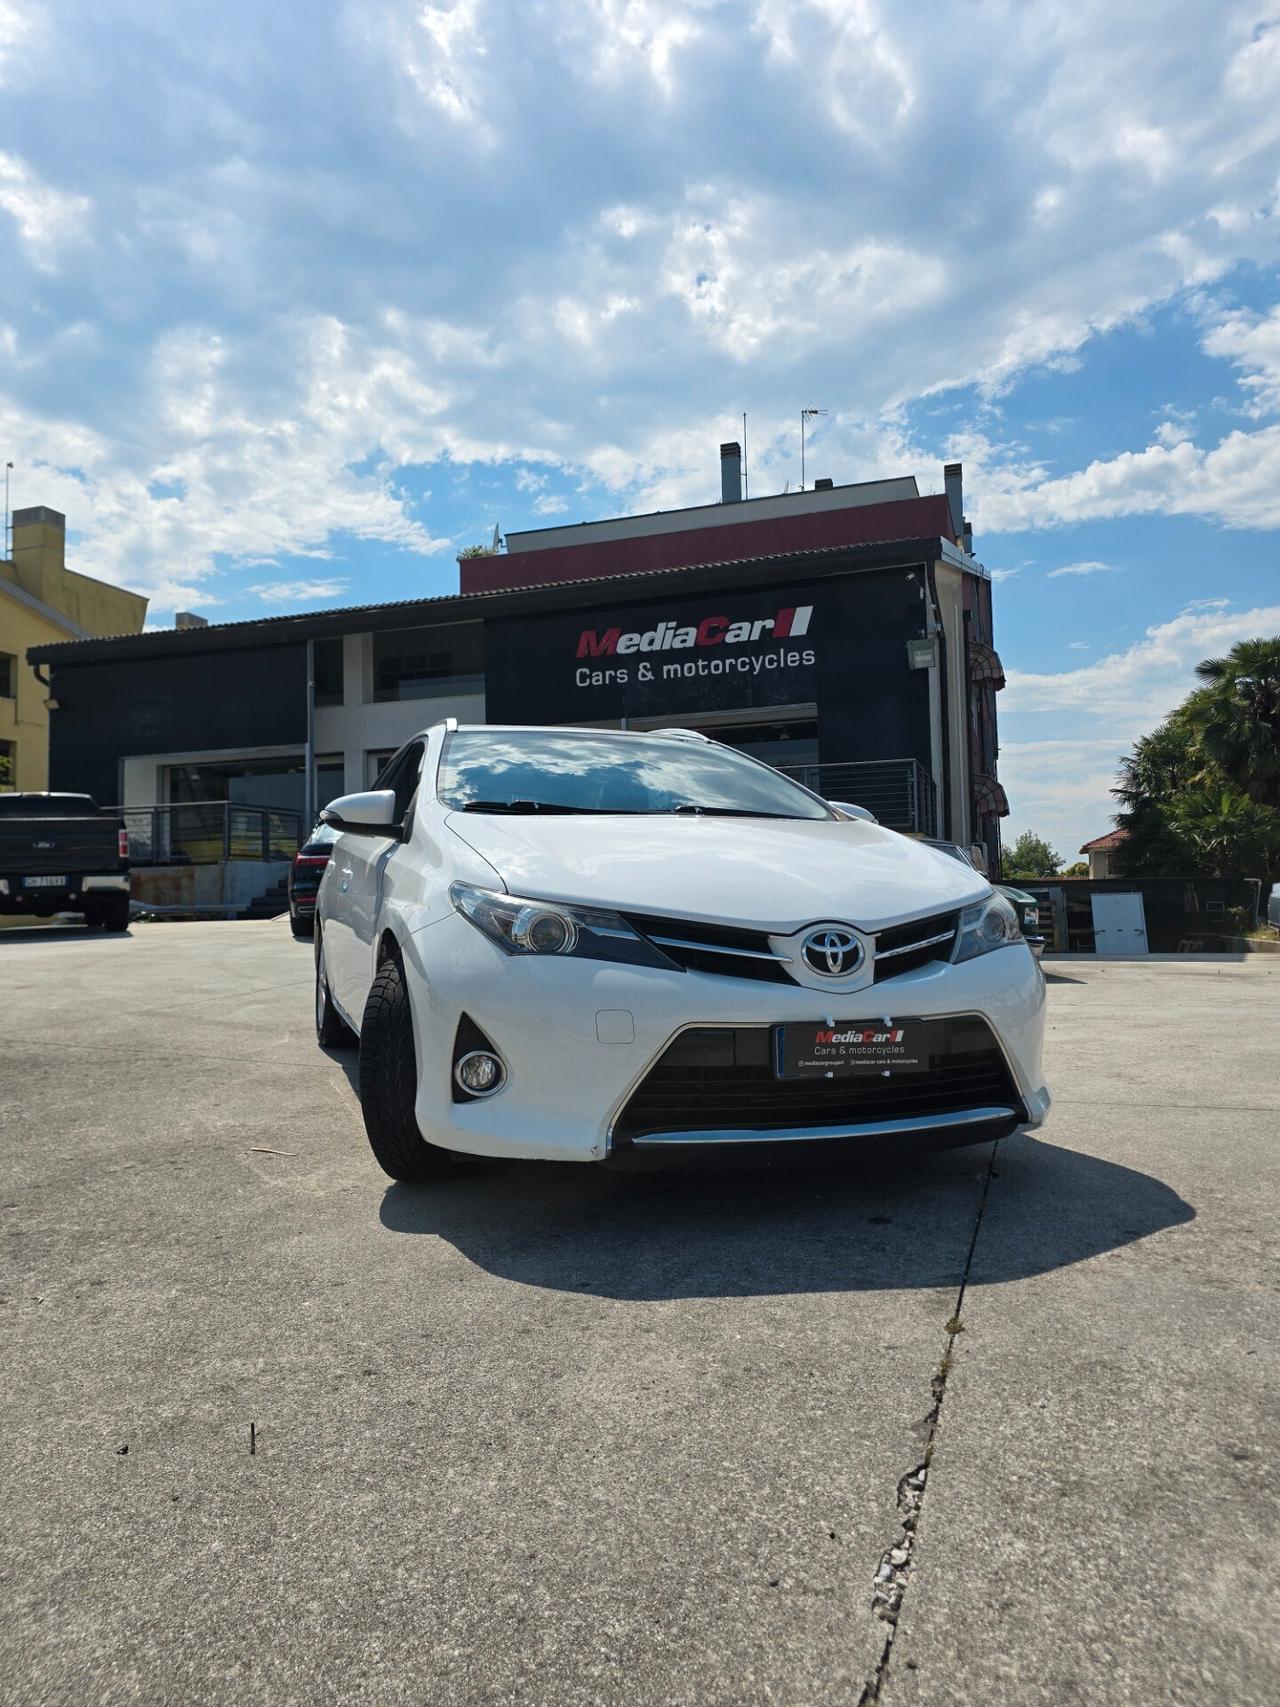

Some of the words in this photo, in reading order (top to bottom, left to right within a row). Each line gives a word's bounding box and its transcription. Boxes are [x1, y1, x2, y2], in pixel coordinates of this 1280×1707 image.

[575, 667, 629, 687] Cars
[637, 662, 655, 681] &
[663, 648, 816, 679] motorcycles
[814, 1046, 837, 1056] Cars
[839, 1046, 846, 1054] &
[849, 1045, 905, 1056] motorcycles
